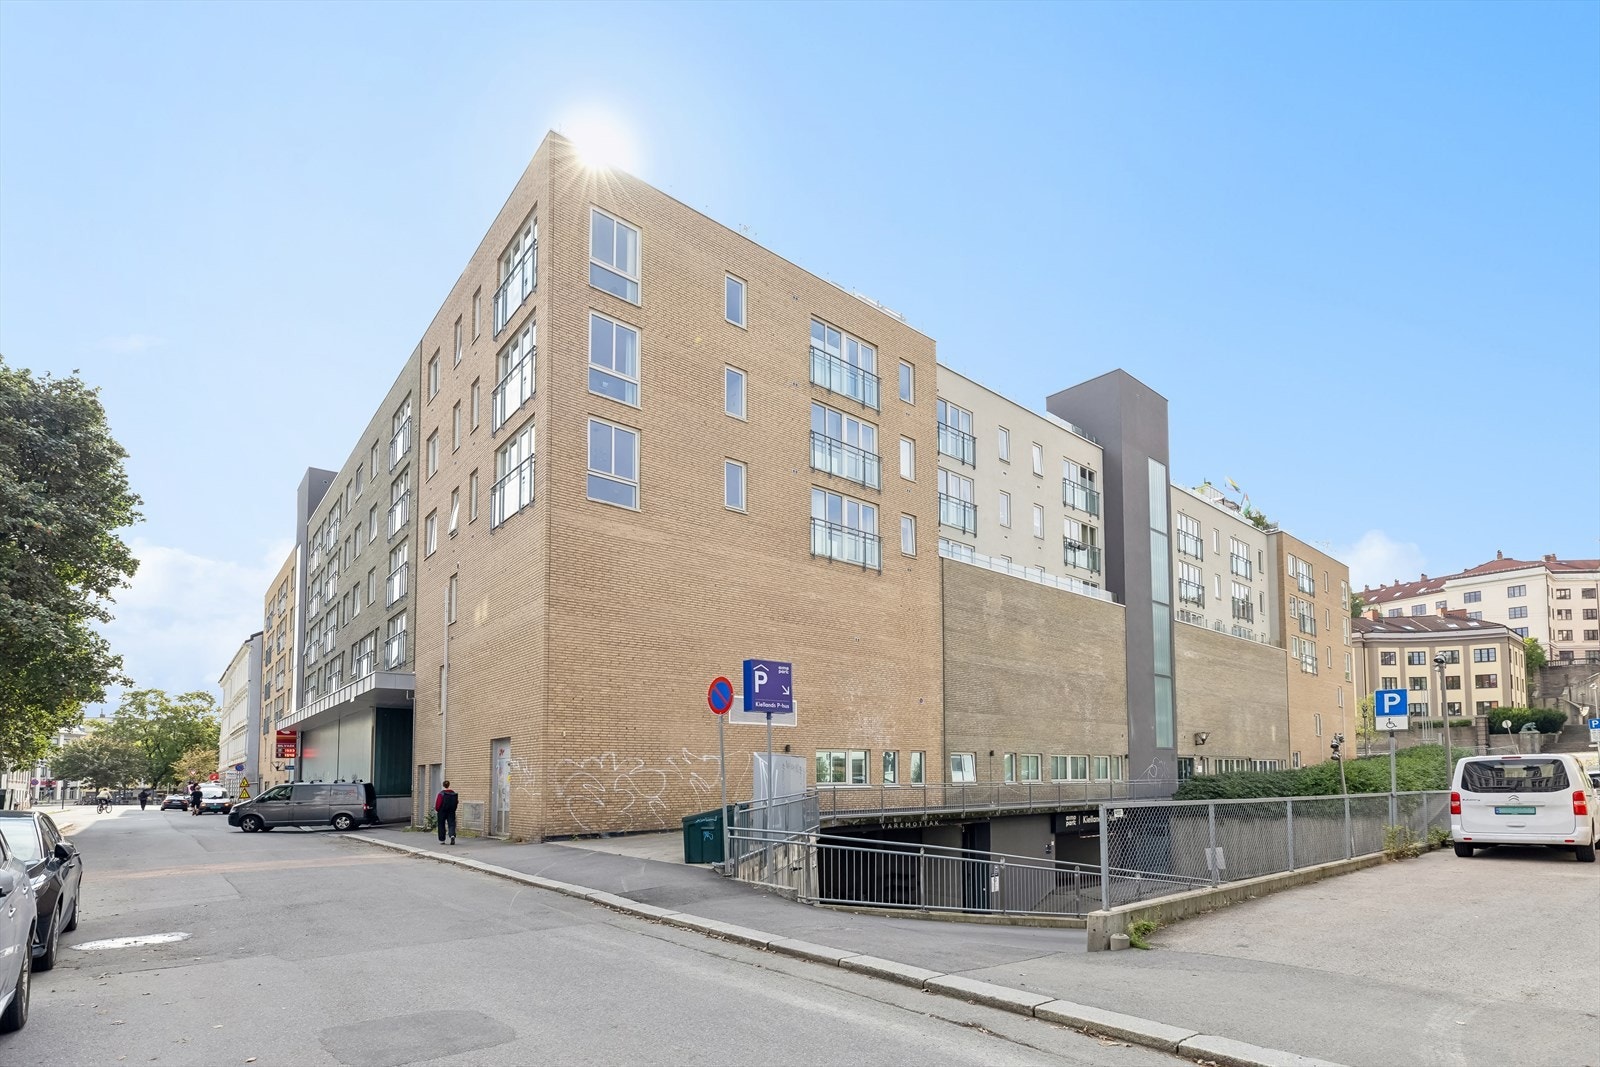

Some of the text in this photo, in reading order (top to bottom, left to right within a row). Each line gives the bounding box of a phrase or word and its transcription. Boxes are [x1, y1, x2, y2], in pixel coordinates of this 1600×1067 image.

[755, 671, 768, 693] P
[1384, 693, 1401, 713] P
[1592, 720, 1599, 728] P
[1083, 815, 1099, 824] Kiellan
[881, 820, 940, 829] VAREMOTTAK
